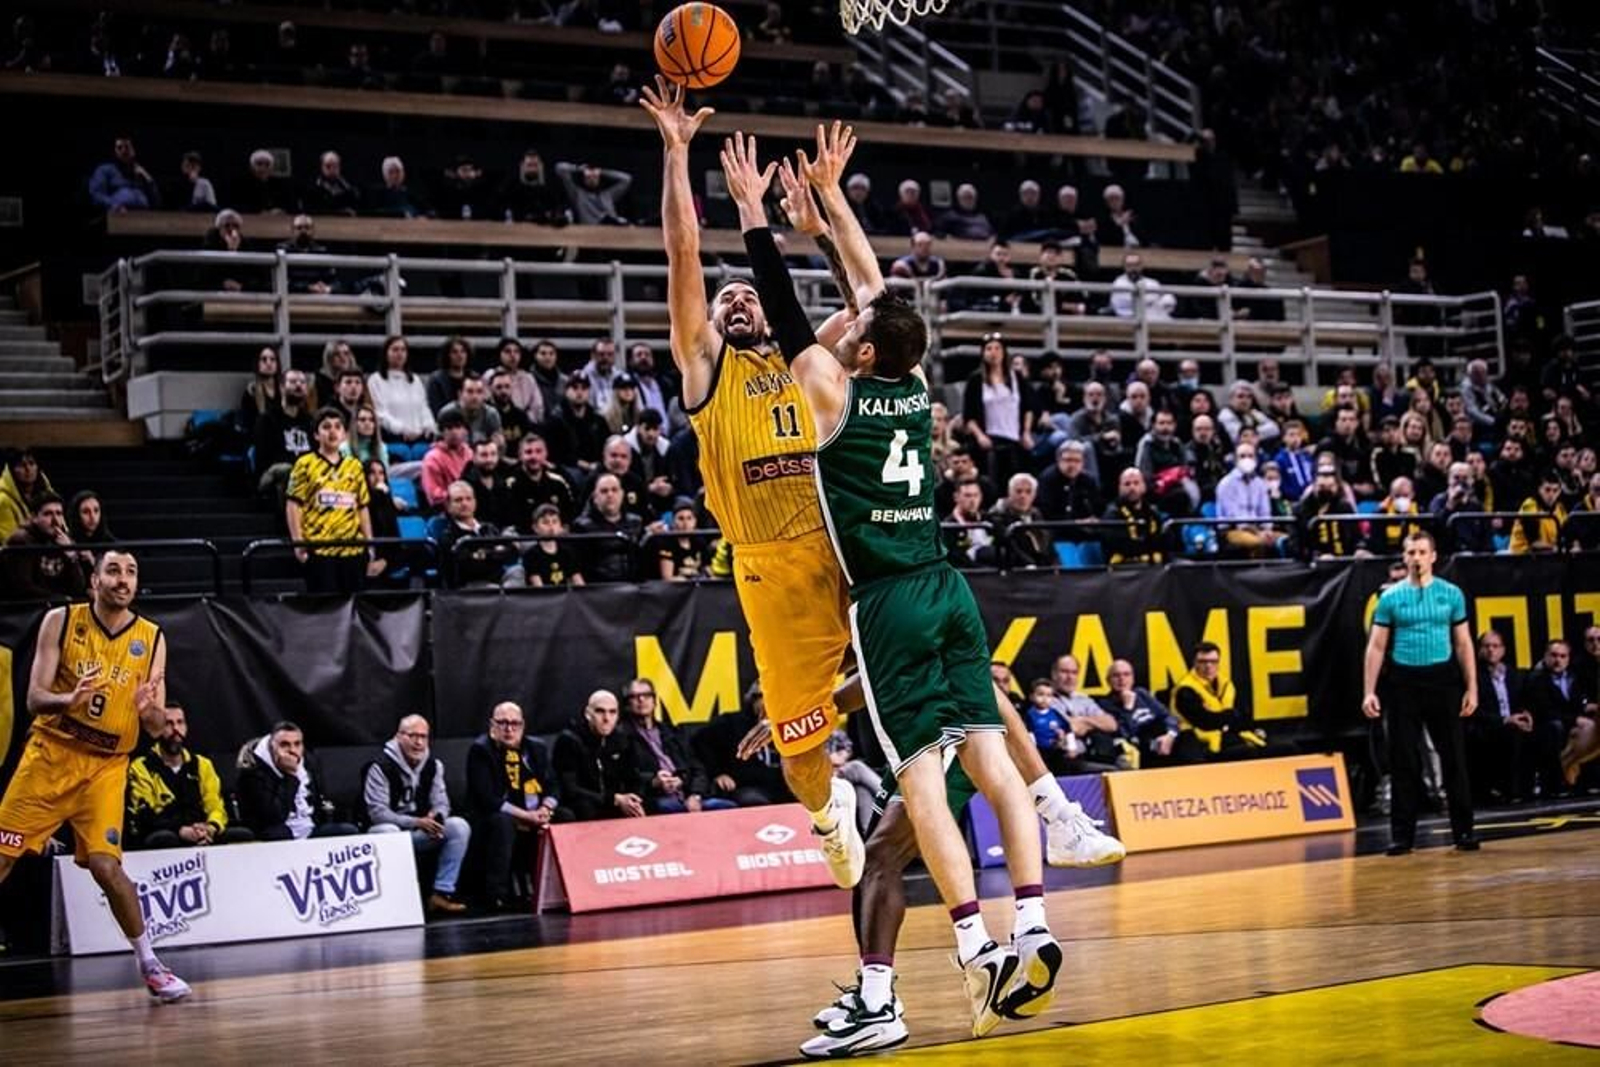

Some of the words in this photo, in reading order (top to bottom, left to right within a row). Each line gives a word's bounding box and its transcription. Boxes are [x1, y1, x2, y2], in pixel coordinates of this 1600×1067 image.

[771, 403, 802, 439] 11
[881, 429, 925, 497] 4
[88, 692, 107, 719] 9
[782, 709, 825, 743] AVIS
[1130, 798, 1211, 821] ΤΡΑΠΕΖΑ
[325, 843, 372, 868] Juice
[593, 861, 694, 884] BIOSTEEL
[139, 876, 204, 920] iva
[276, 860, 374, 915] Viva
